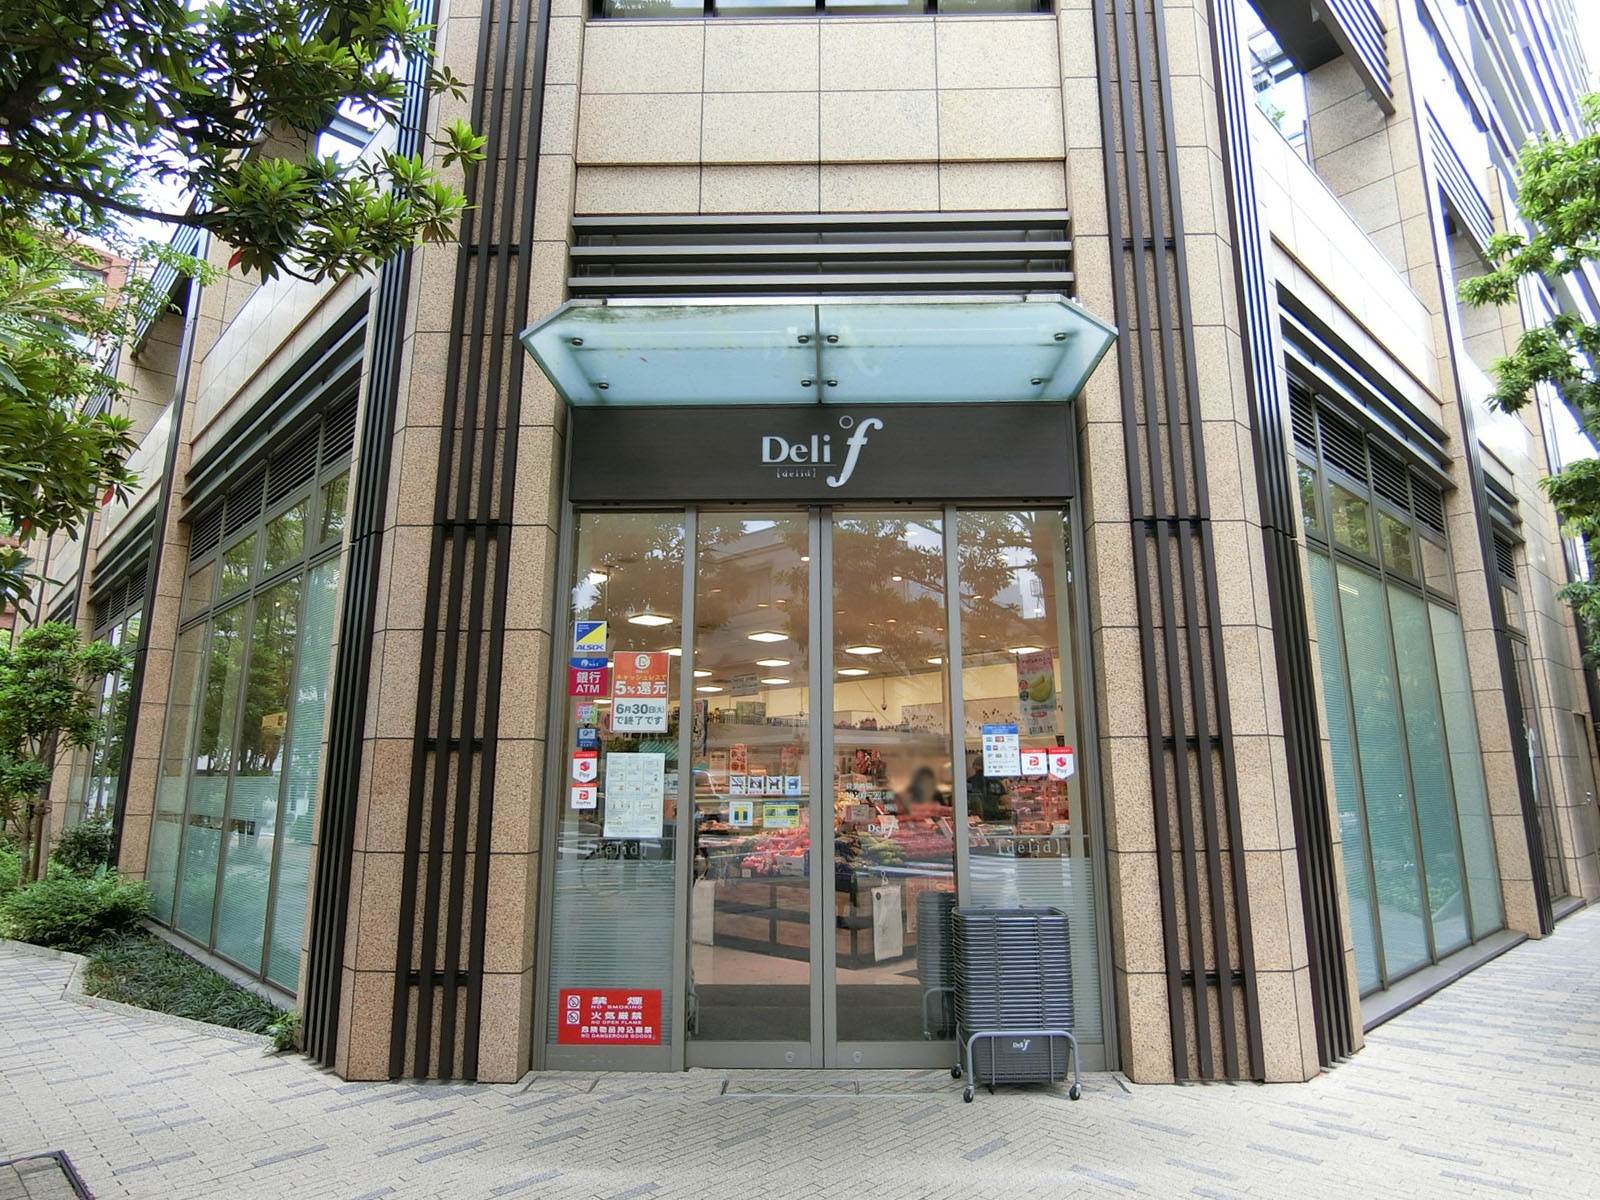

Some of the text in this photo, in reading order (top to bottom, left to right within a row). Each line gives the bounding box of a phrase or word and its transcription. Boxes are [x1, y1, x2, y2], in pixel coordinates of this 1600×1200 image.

[762, 435, 831, 463] Deli
[576, 671, 601, 684] 銀行
[576, 684, 600, 693] ATM
[615, 716, 663, 725] で終了です
[591, 1011, 642, 1020] 火気厳禁
